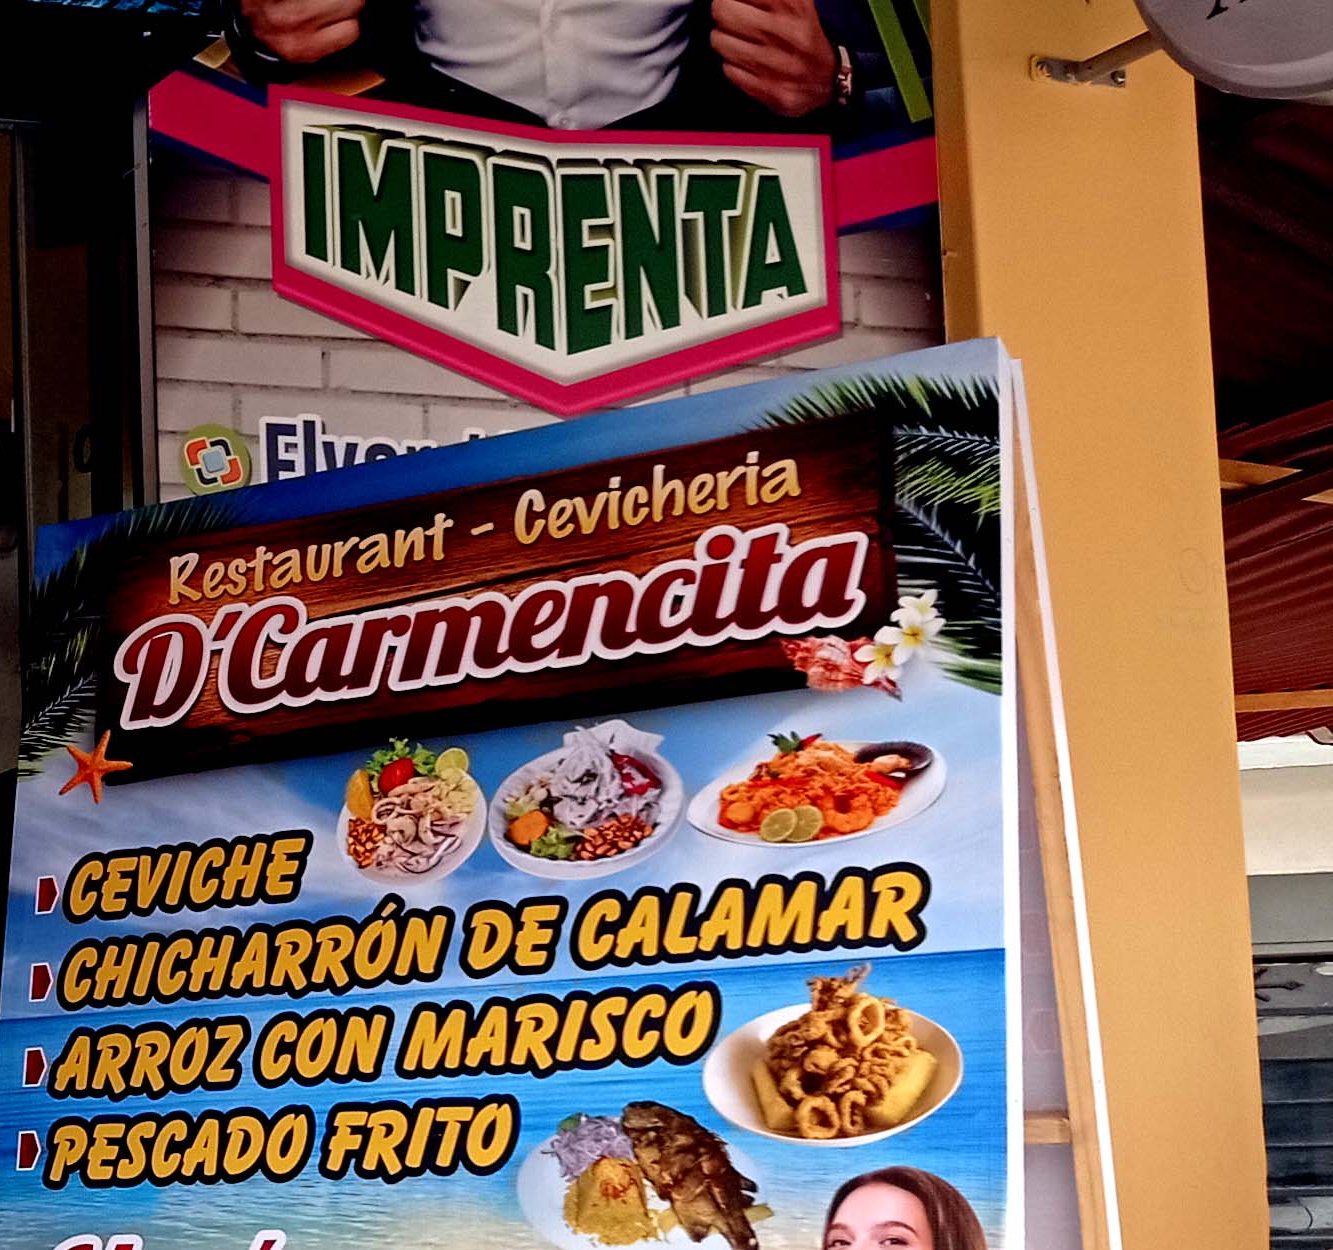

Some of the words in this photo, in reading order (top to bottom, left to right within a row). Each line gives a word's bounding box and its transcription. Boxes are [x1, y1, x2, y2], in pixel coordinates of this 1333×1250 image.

[301, 125, 808, 357] IMPRENTA
[169, 511, 455, 604] Restaurant
[514, 451, 801, 546] Cevicheria
[121, 527, 866, 727] D'Carmencita
[62, 902, 450, 1005] CHICHARRÓN
[471, 909, 553, 974] DE
[577, 871, 925, 965] CALAMAR
[68, 841, 299, 920] CEVICHE
[51, 1026, 241, 1095] ARROZ
[263, 1017, 387, 1085] CON
[402, 991, 718, 1074] MARISCO
[46, 1110, 313, 1187] PESCADO
[327, 1100, 517, 1178] FRITO
